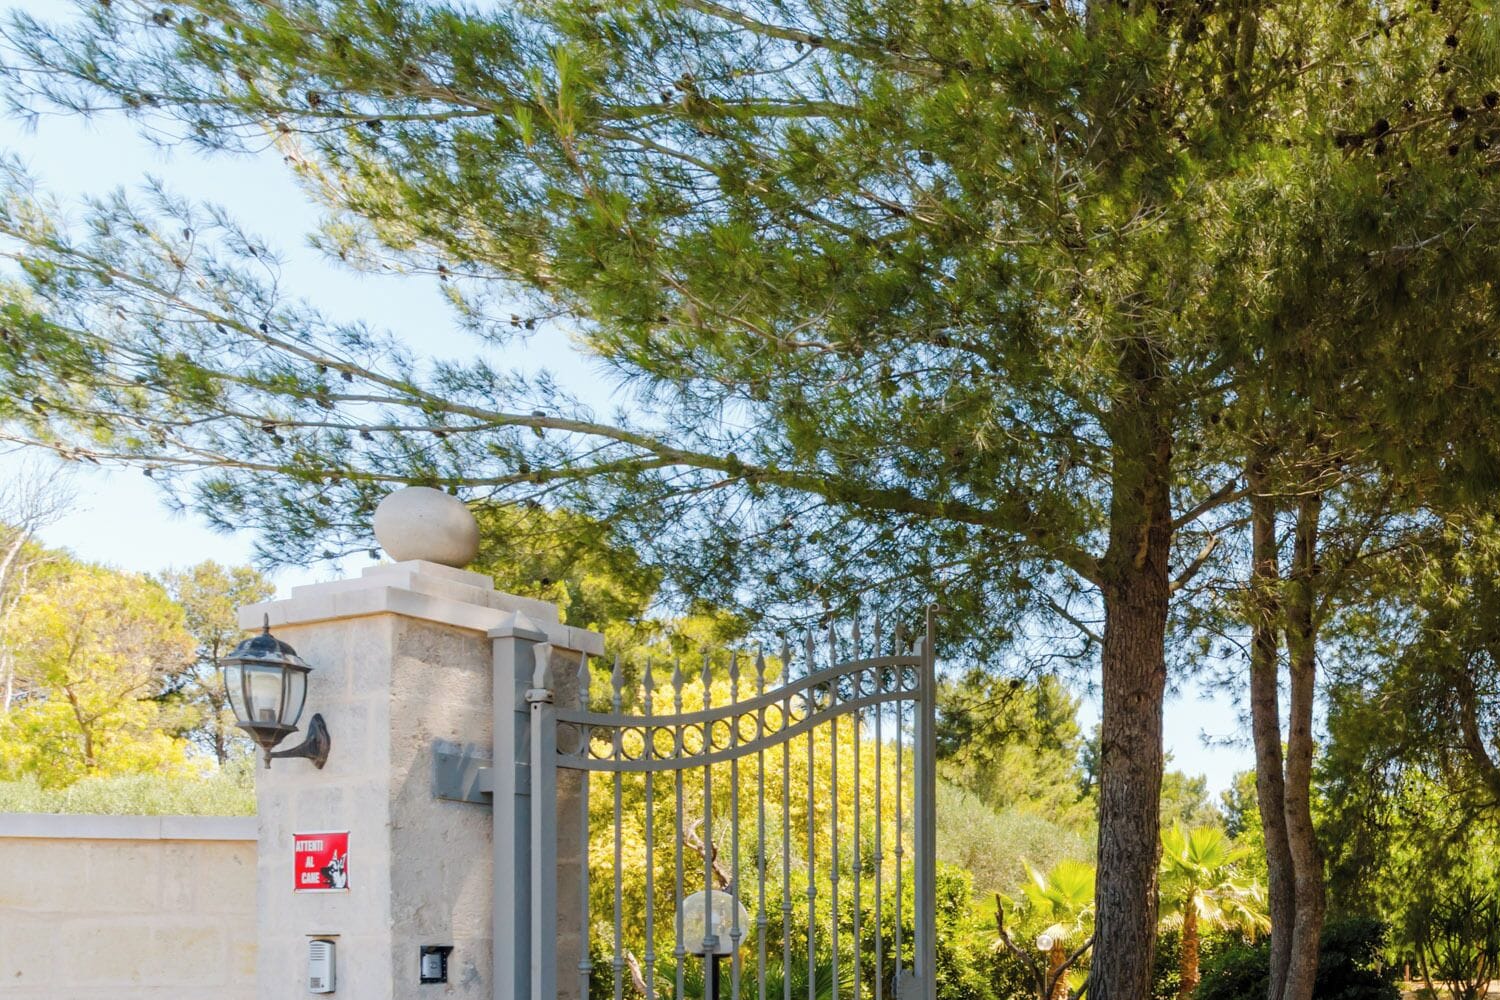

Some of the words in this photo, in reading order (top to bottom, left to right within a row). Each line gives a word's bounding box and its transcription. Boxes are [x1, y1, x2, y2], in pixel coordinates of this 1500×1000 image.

[295, 840, 323, 852] ATTENTI
[305, 856, 315, 867] AL
[302, 872, 320, 884] CANE
